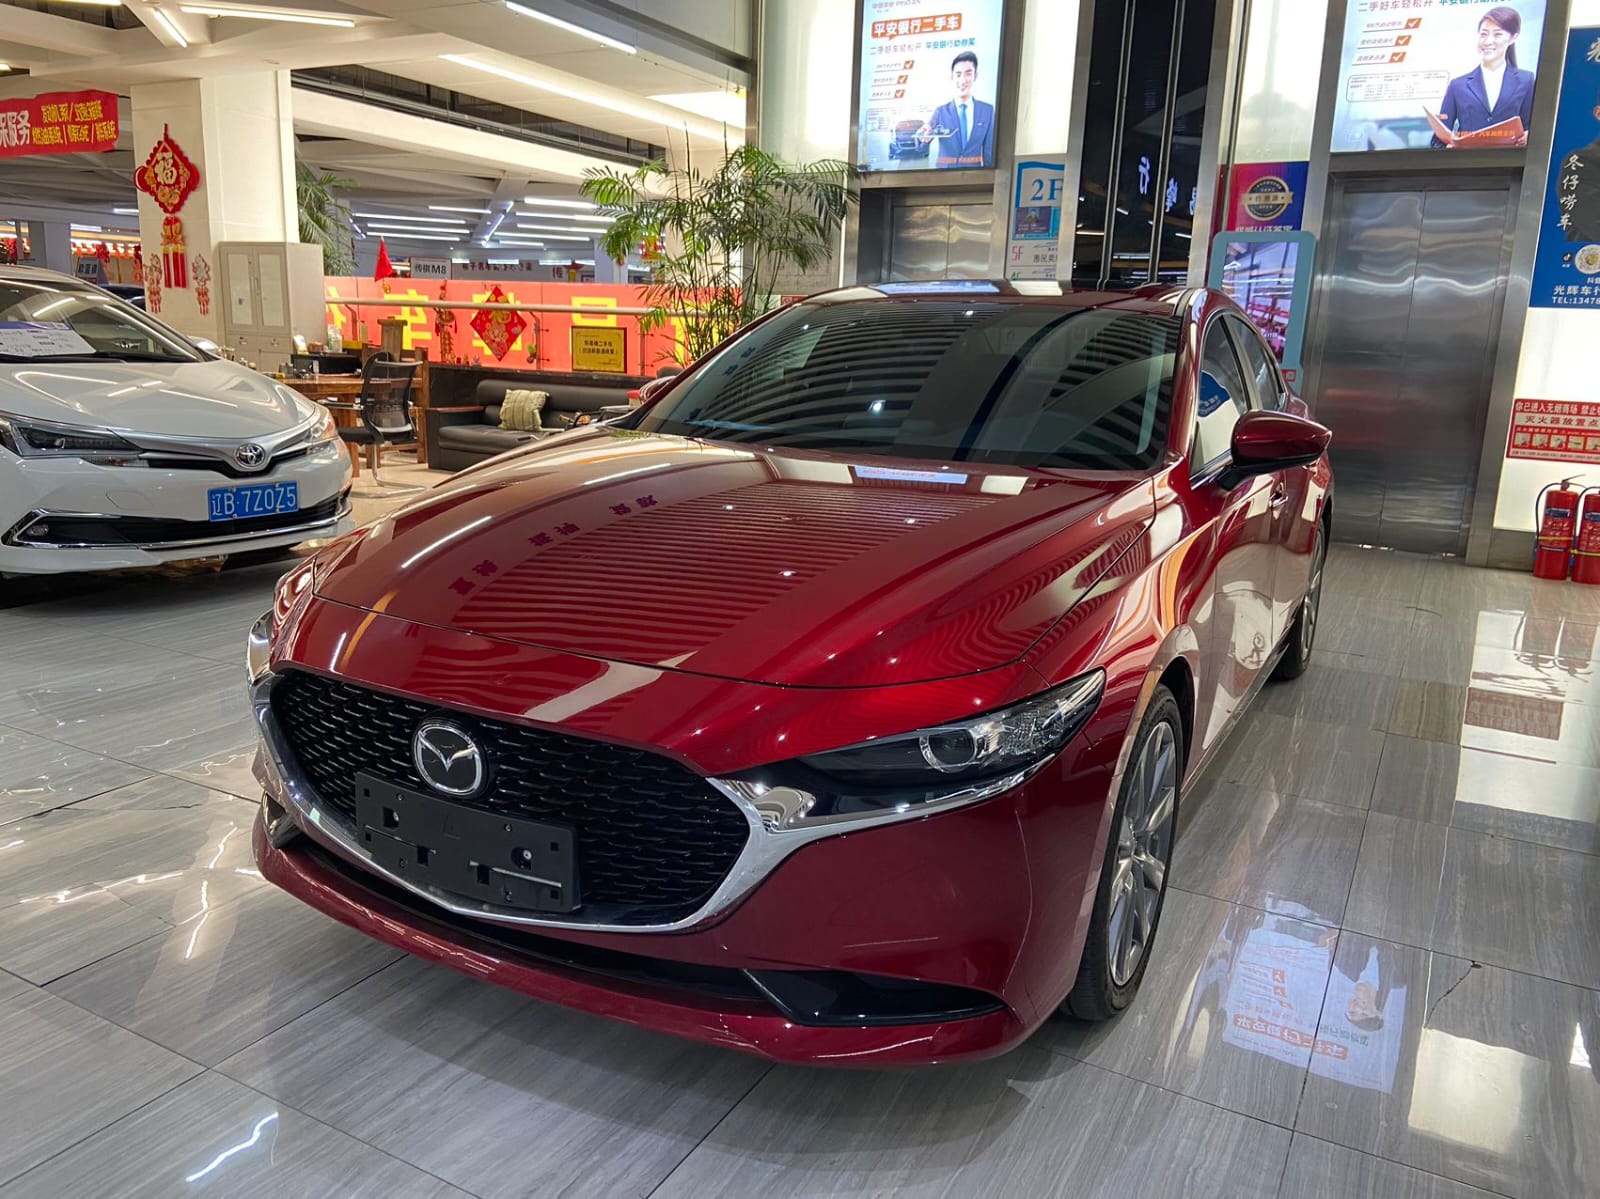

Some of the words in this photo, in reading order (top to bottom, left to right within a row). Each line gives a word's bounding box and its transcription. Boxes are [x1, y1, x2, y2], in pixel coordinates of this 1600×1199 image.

[874, 16, 960, 37] 平安银行二手车
[1030, 178, 1063, 200] 2F
[1526, 416, 1598, 427] 灭火器放置点
